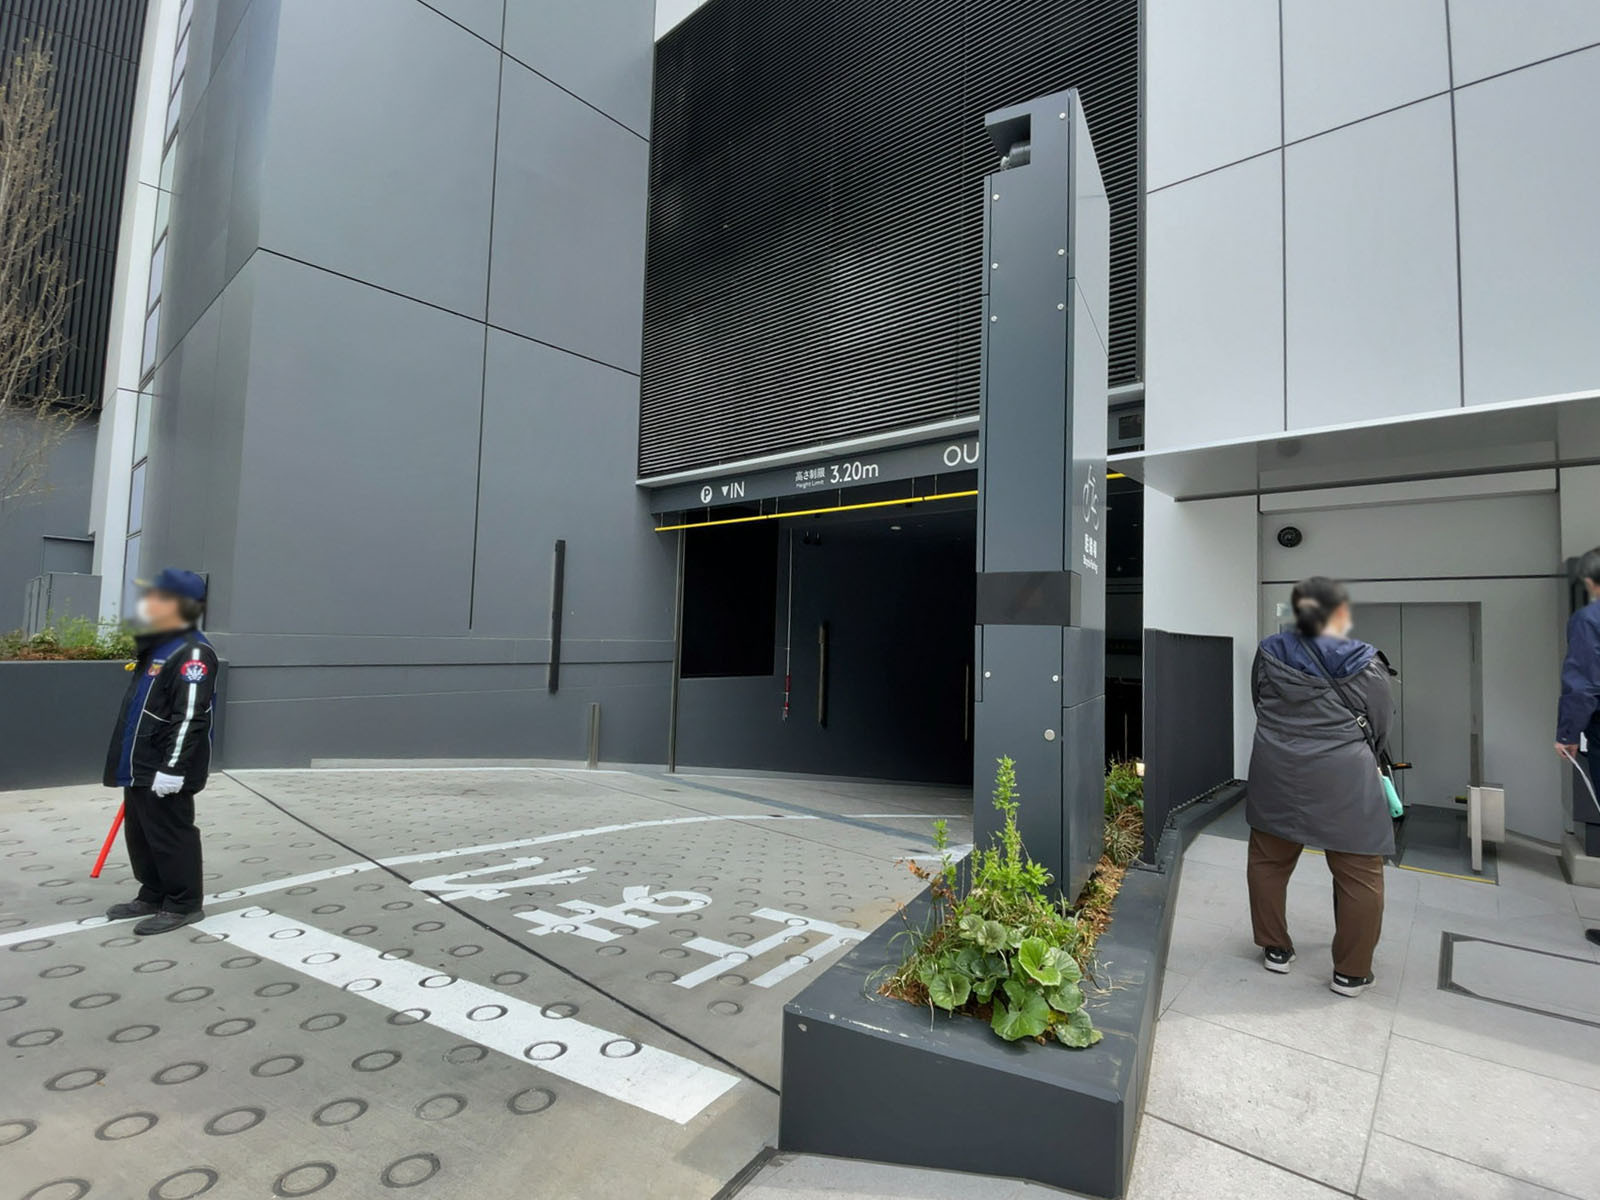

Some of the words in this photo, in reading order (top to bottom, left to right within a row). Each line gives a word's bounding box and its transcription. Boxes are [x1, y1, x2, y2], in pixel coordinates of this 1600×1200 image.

[943, 441, 980, 467] OU
[830, 461, 879, 484] 3.20m
[730, 481, 745, 499] IN
